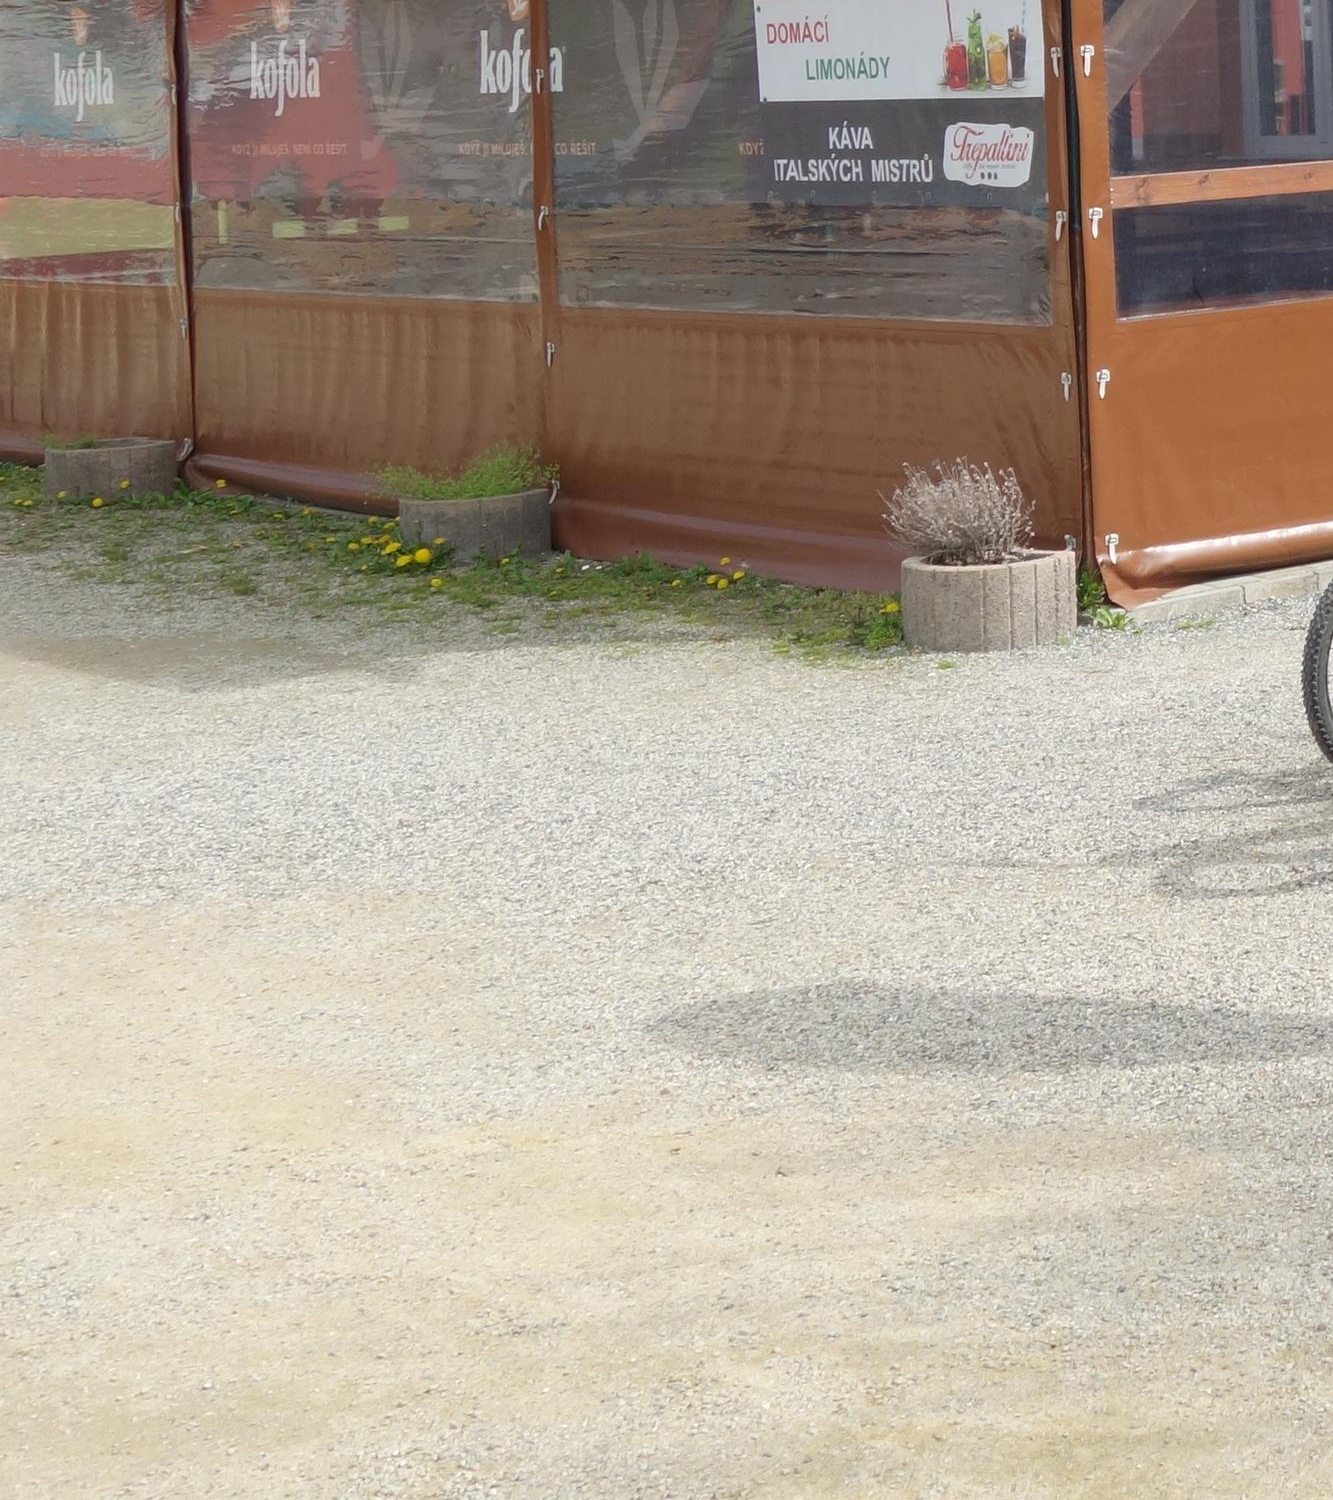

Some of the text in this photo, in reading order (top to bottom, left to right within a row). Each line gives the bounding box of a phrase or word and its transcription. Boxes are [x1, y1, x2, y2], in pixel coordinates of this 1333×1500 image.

[766, 15, 829, 44] DOMÁCÍ
[250, 39, 321, 117] kofola
[480, 28, 564, 113] kofoa
[805, 51, 890, 81] LIMONÁDY
[53, 50, 114, 122] kofola
[828, 120, 874, 150] KÁVA
[774, 153, 933, 183] ITALSKÝCH MISTRŮ
